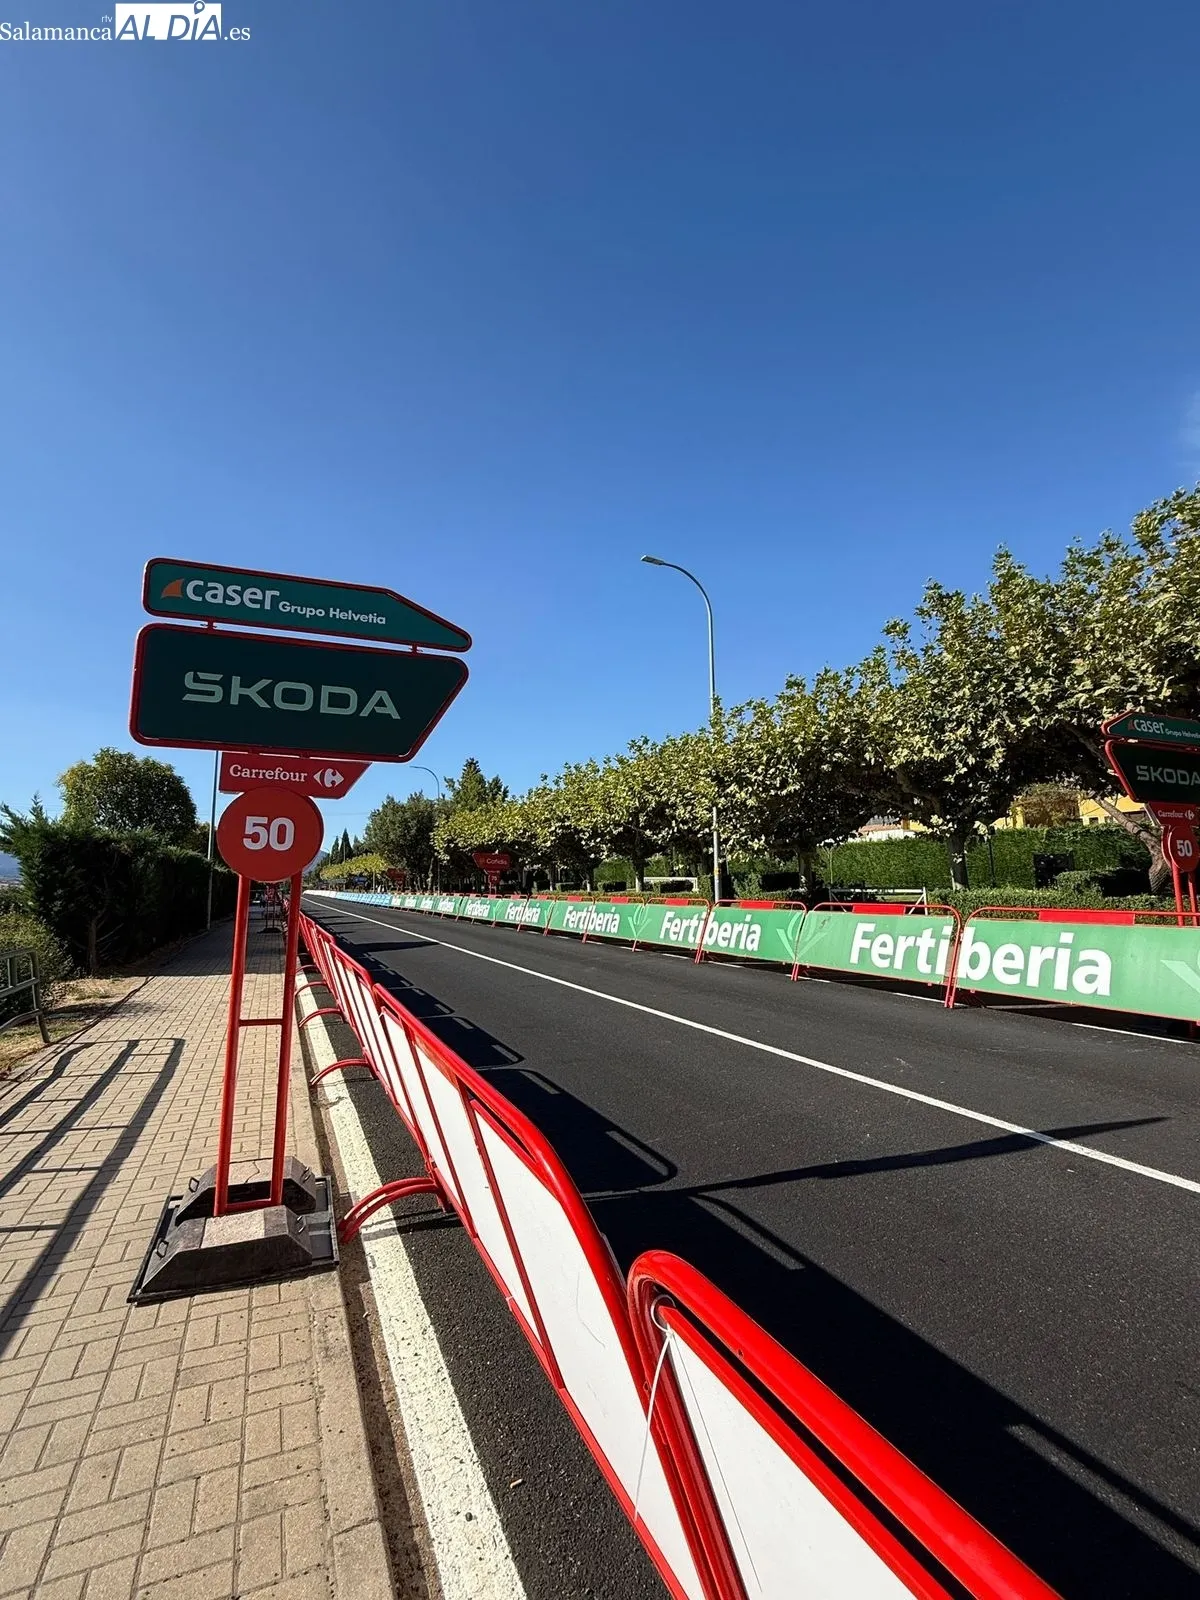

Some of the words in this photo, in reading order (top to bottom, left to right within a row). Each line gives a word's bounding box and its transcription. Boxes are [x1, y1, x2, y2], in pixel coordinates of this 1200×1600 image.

[186, 579, 281, 610] caser
[279, 601, 326, 618] Grupo
[329, 607, 387, 626] Helvetia
[1134, 719, 1165, 734] caser
[229, 764, 308, 783] Carrefour
[1158, 809, 1184, 819] Carrefour
[243, 815, 295, 852] 50
[1176, 839, 1193, 857] 50
[504, 901, 541, 923] Fertiberia
[562, 905, 621, 934] Fertiberia
[659, 909, 762, 952] Fertiberia
[849, 921, 1112, 997] Fertiberia
